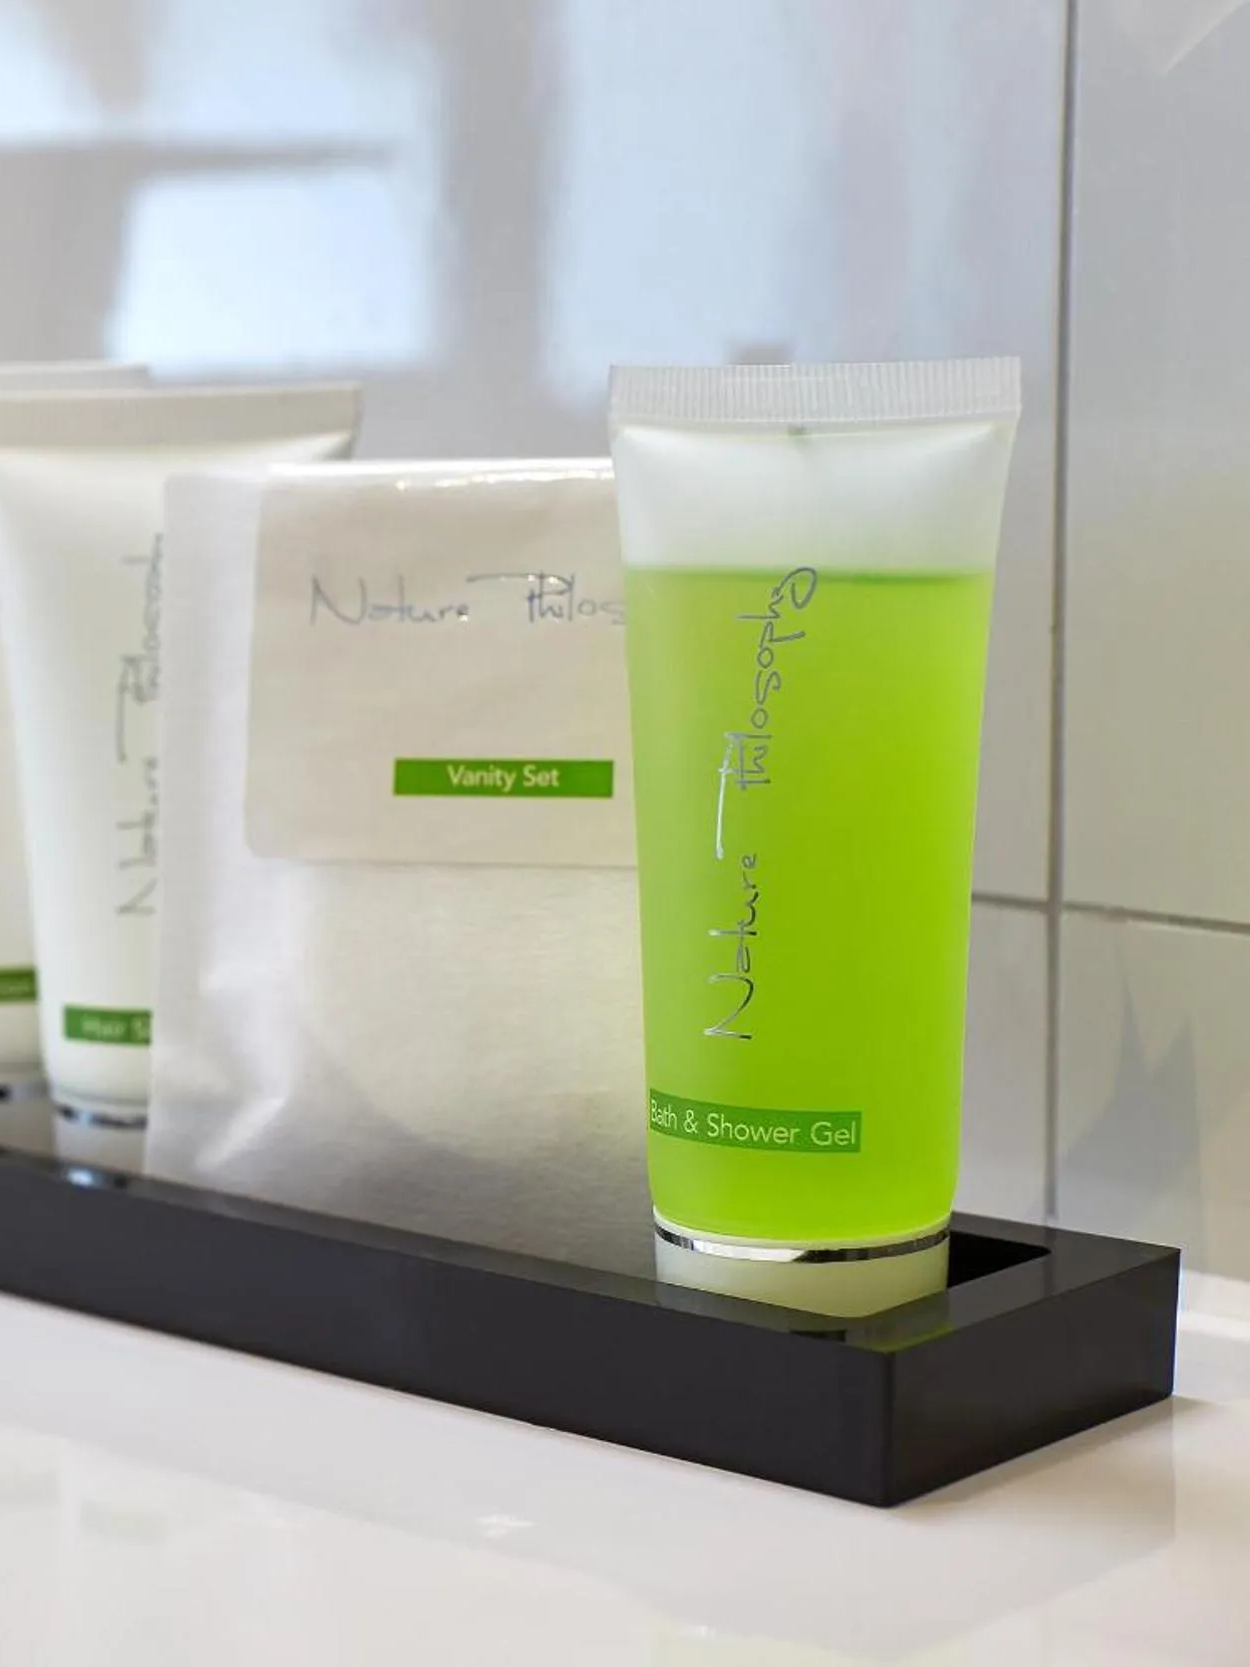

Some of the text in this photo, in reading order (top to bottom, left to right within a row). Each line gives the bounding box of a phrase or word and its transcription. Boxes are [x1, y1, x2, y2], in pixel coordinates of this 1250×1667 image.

[309, 573, 470, 626] Nature
[446, 764, 560, 792] Vanity Set
[703, 566, 817, 1040] Nature Philosophy
[651, 1099, 856, 1147] Bath & Shower Gel
